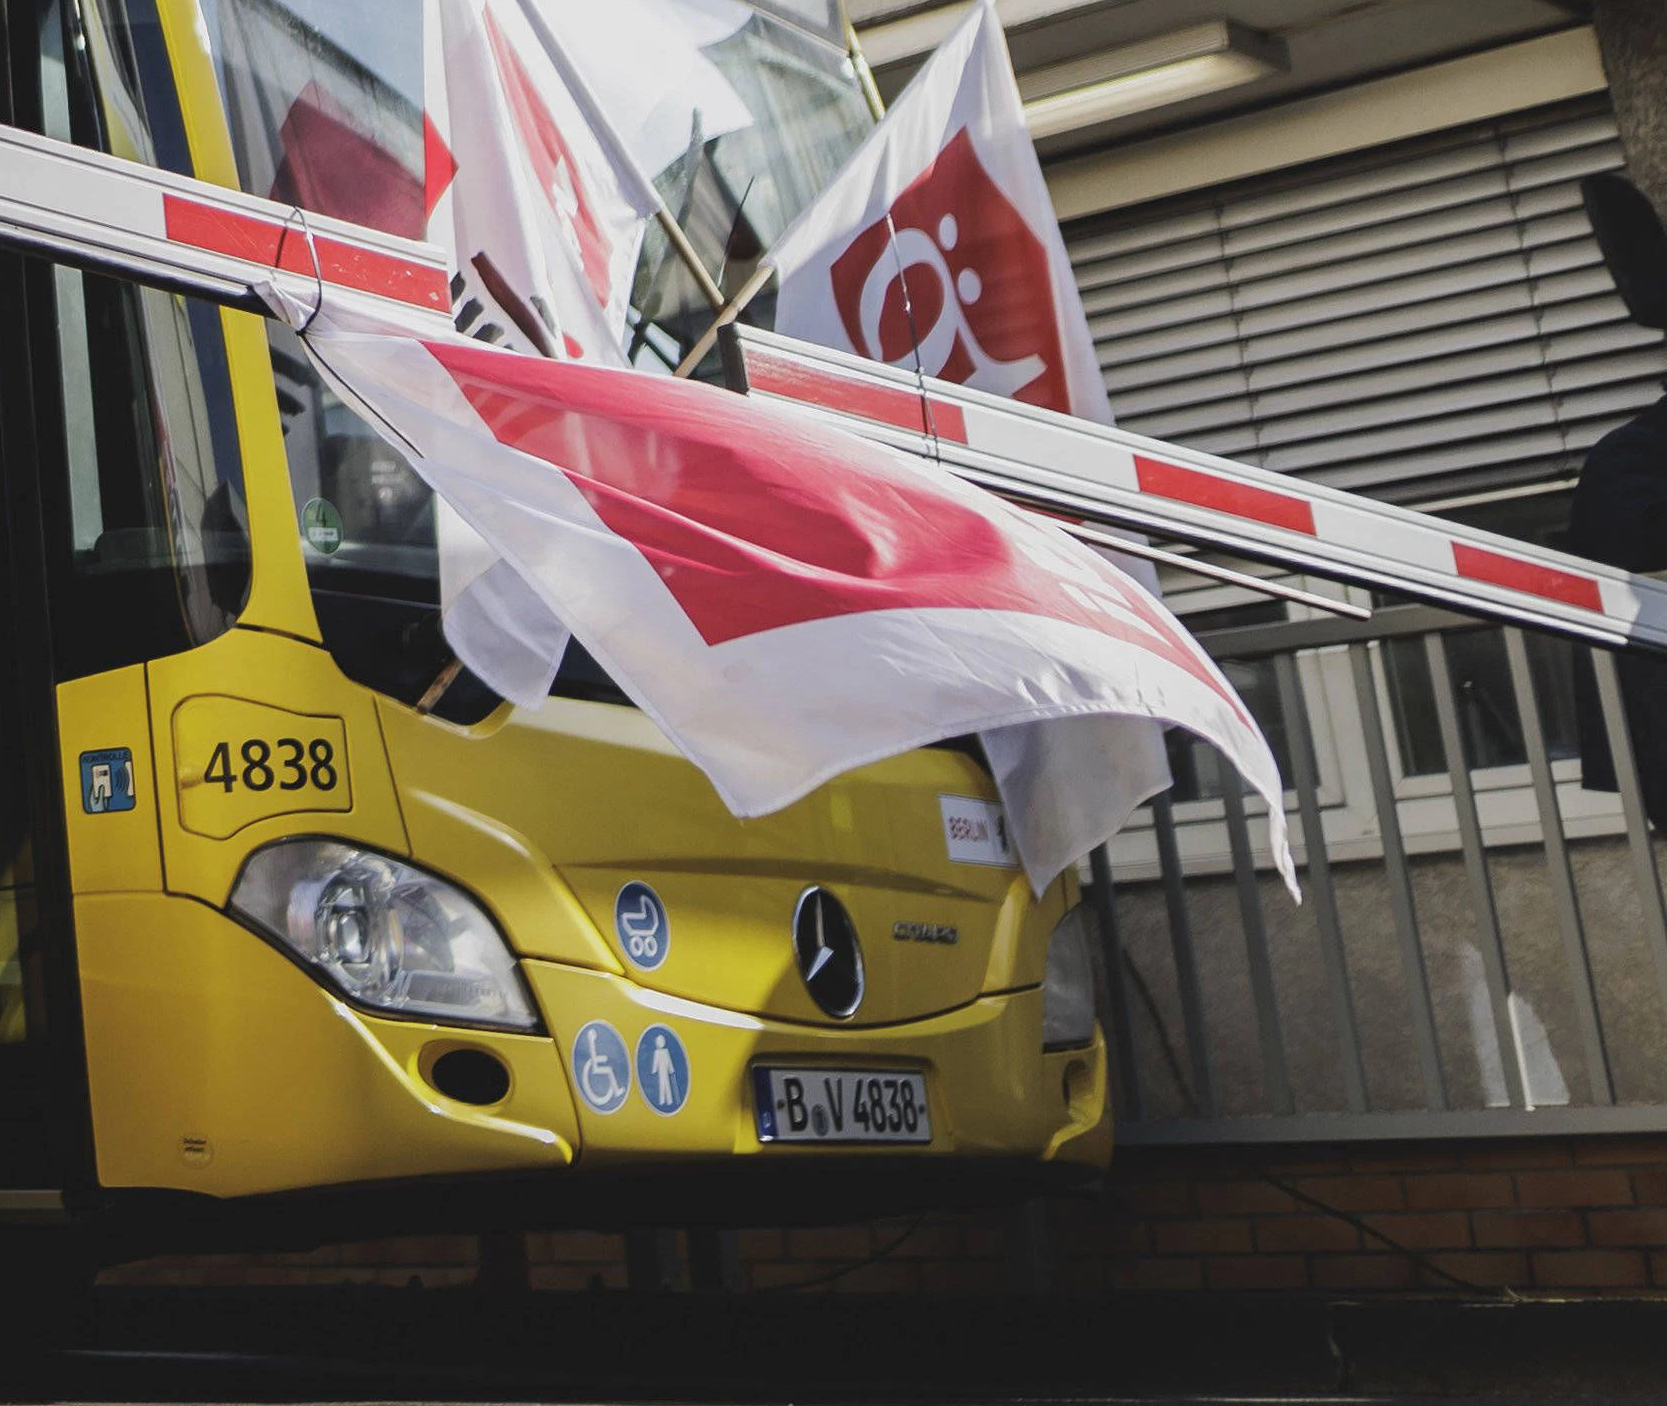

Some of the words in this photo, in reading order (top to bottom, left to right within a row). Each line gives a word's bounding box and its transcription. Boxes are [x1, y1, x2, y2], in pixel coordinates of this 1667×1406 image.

[204, 738, 337, 793] 4838
[784, 1077, 808, 1132] B
[823, 1078, 843, 1132] V
[853, 1079, 918, 1133] 4838
